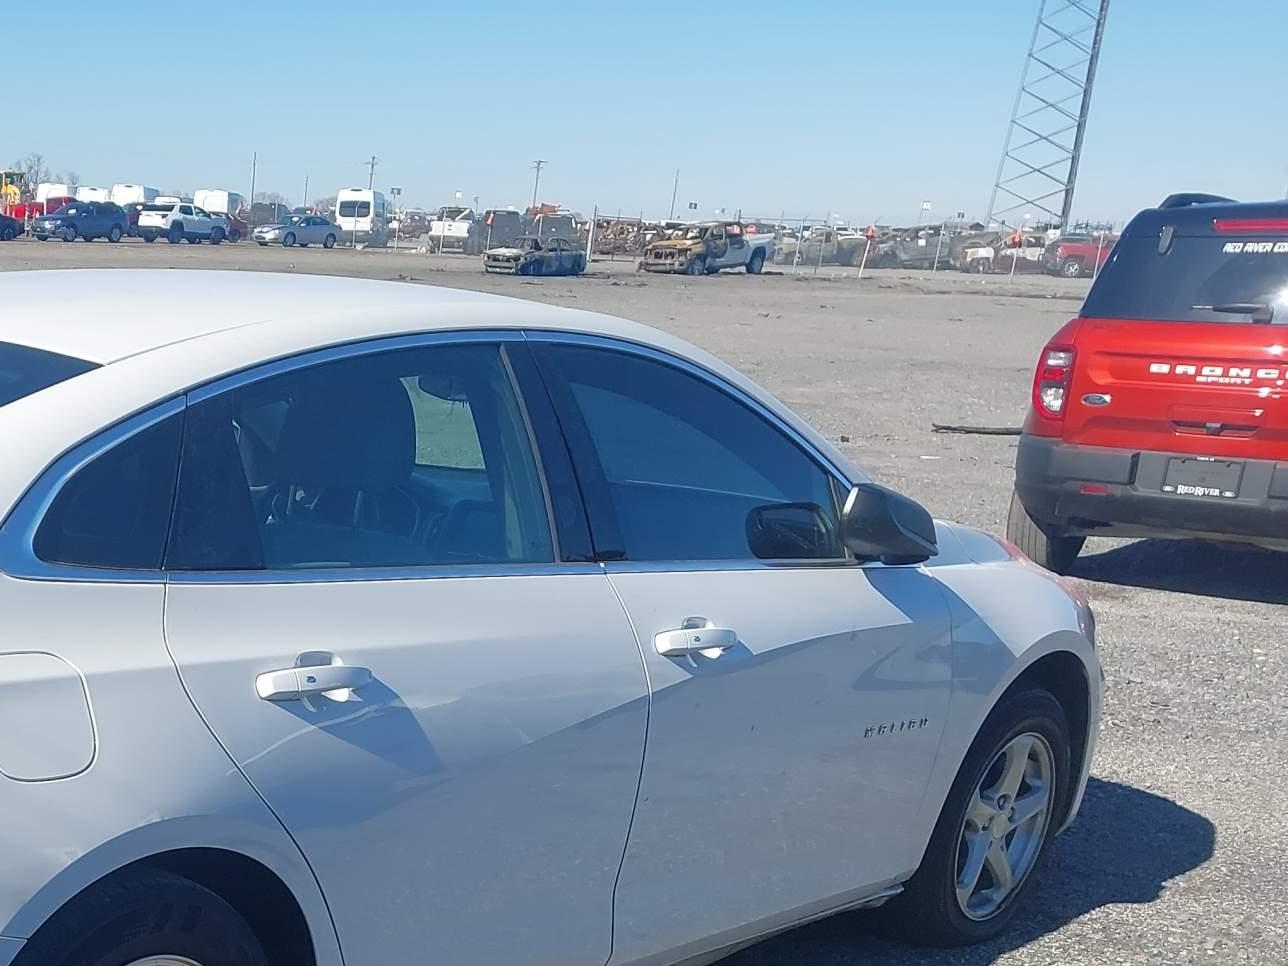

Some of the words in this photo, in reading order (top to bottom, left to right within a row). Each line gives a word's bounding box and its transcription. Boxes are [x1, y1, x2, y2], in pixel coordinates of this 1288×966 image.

[1223, 242, 1243, 253] RED
[1243, 242, 1273, 253] RIVER
[1195, 375, 1254, 385] SPORT
